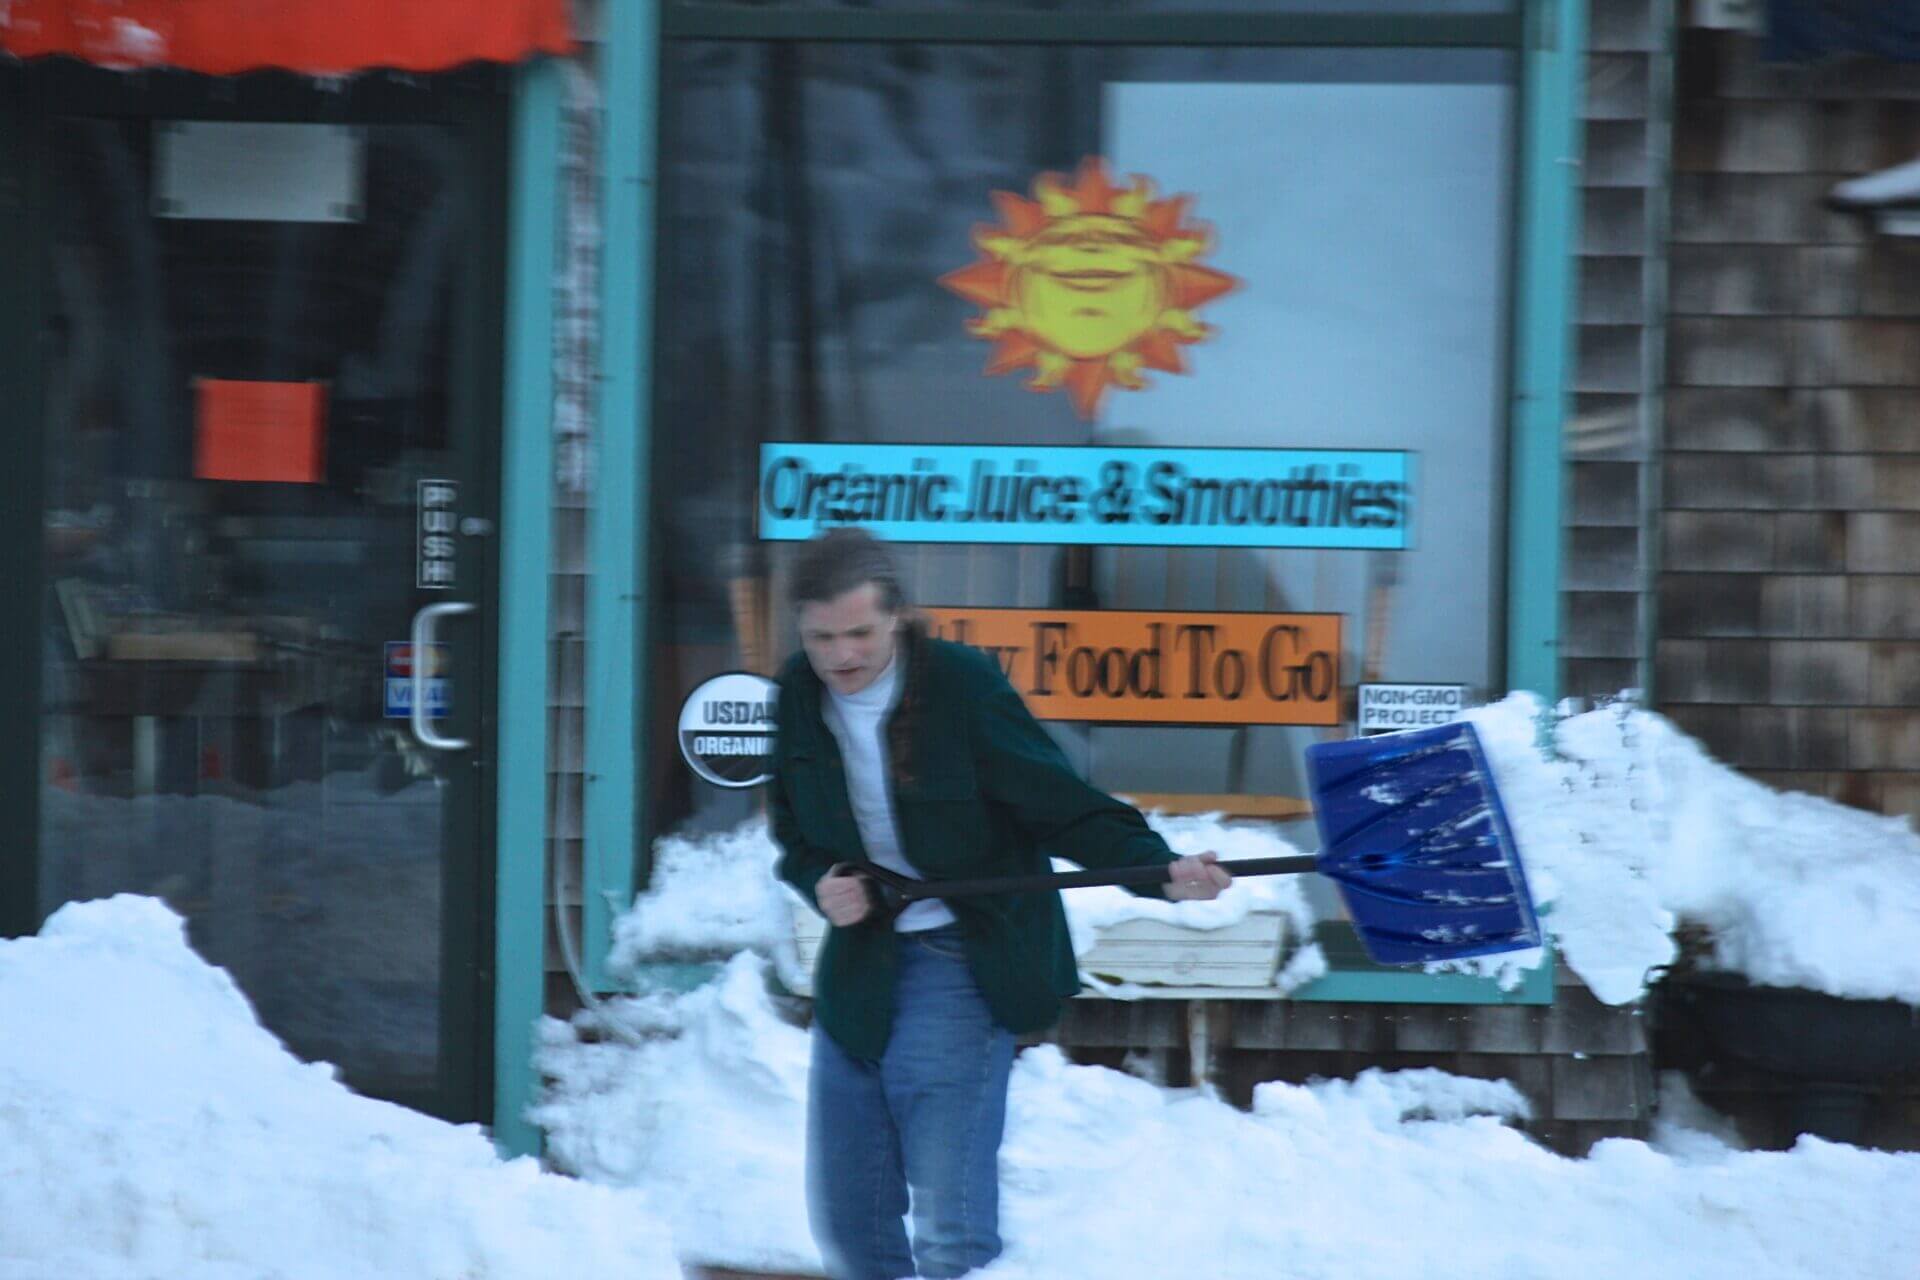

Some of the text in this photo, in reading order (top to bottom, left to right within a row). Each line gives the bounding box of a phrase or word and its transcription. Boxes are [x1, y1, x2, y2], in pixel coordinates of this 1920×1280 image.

[764, 456, 1406, 528] Organic Juice & Smoothies
[1030, 622, 1164, 699] Food
[1175, 624, 1246, 699] To
[1258, 624, 1334, 702] Go
[392, 687, 442, 704] VIA
[1364, 690, 1457, 705] NON-GMO
[703, 701, 772, 725] USDA
[1364, 709, 1456, 724] PROJECT
